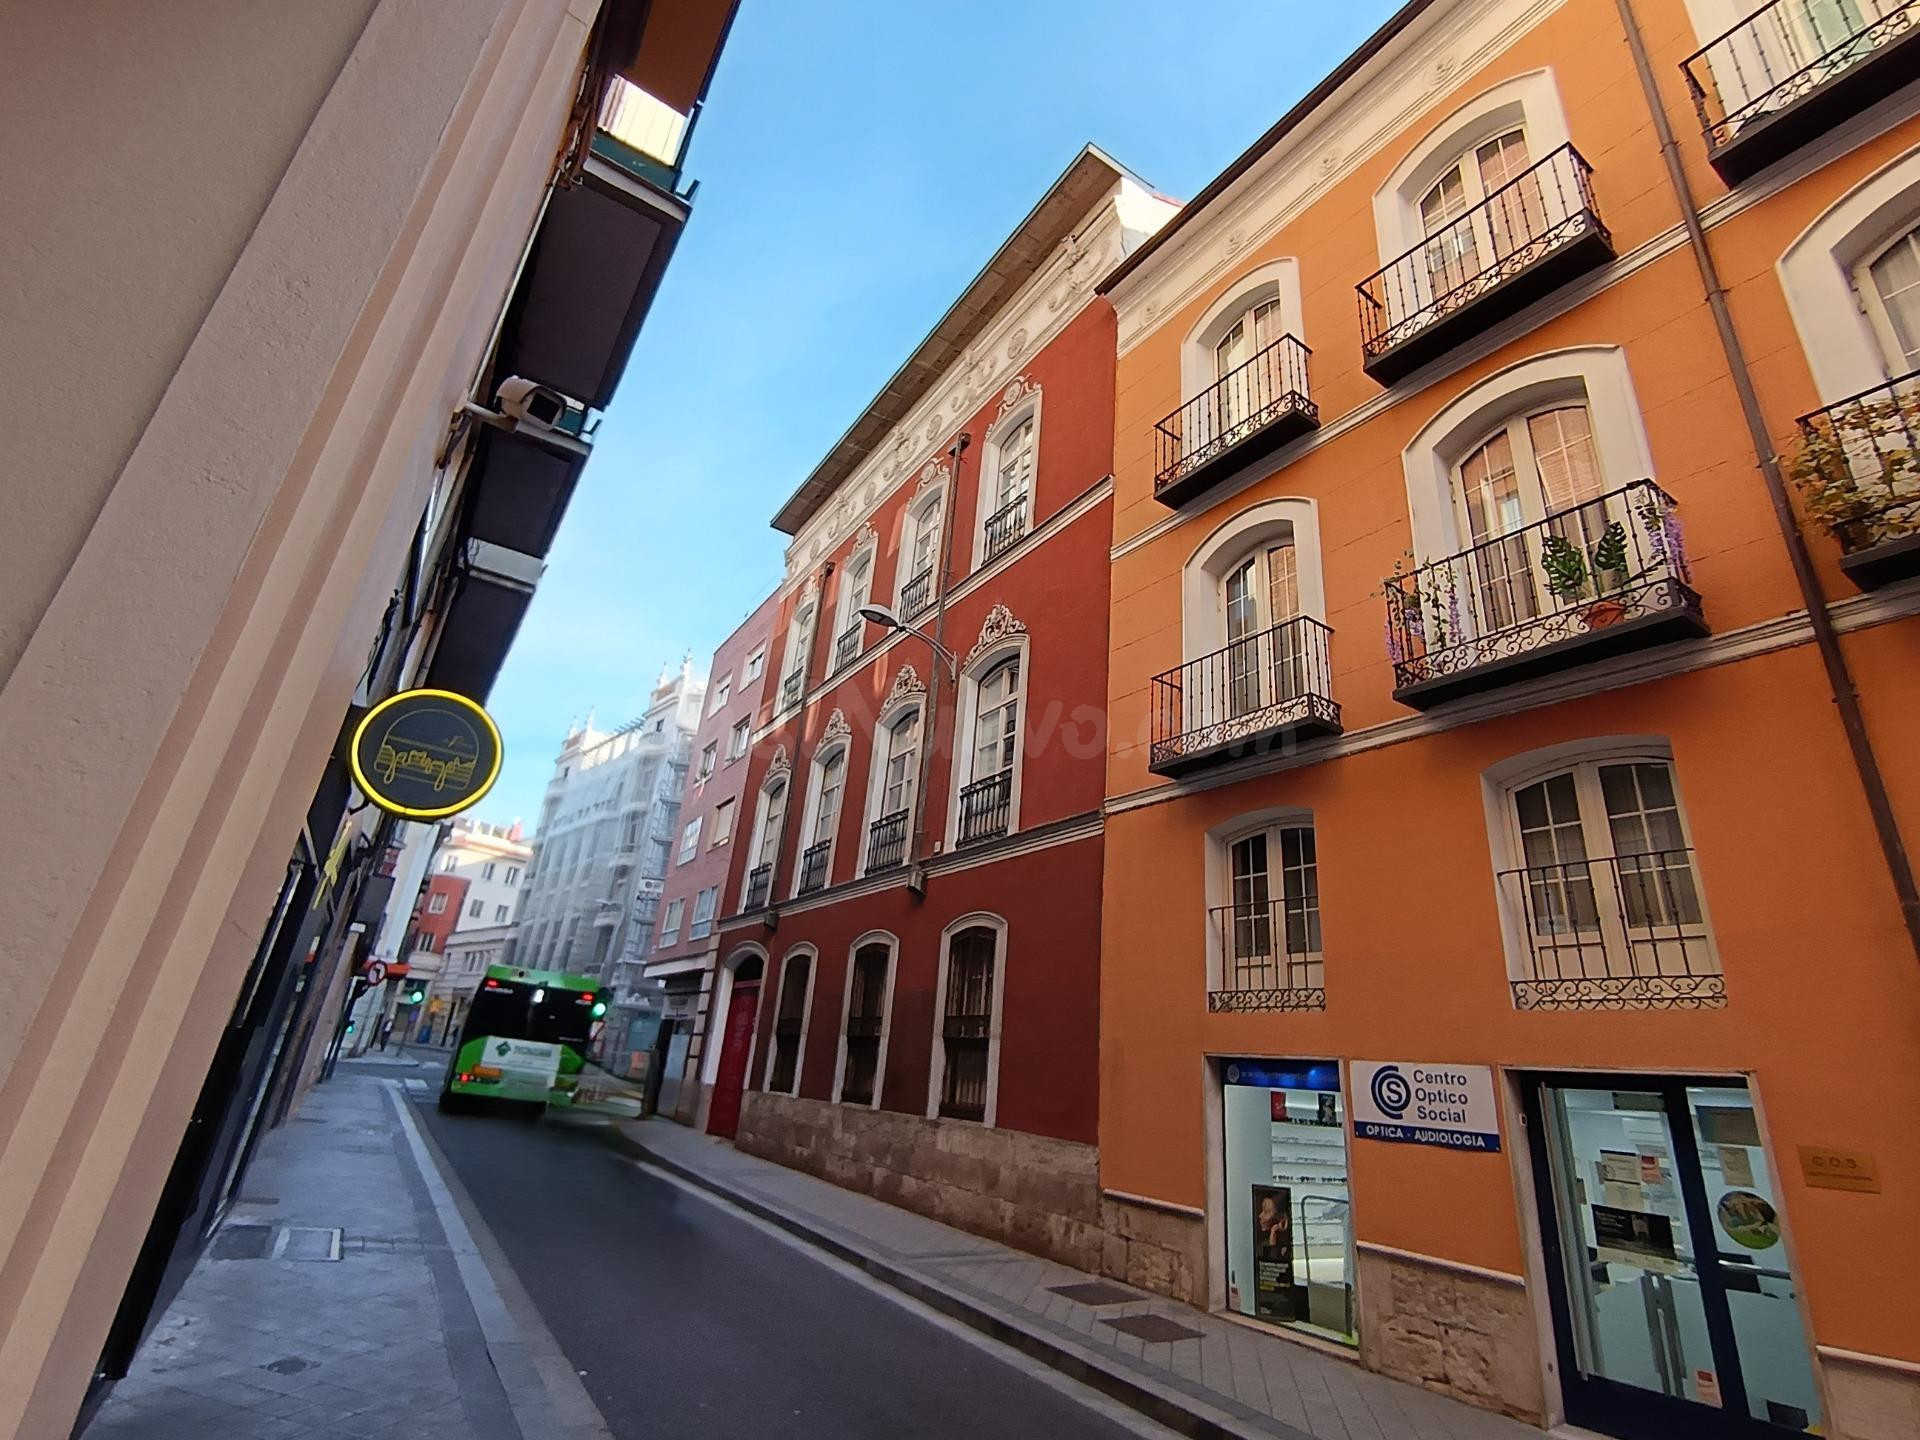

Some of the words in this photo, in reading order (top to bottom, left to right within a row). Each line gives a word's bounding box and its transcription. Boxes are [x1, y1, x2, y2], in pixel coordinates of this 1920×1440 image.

[1413, 1069, 1467, 1086] Centro
[1414, 1087, 1468, 1106] Optico
[1416, 1105, 1466, 1124] Social
[1365, 1124, 1404, 1139] OPTICA
[1414, 1128, 1486, 1148] AUDIOLOGIA
